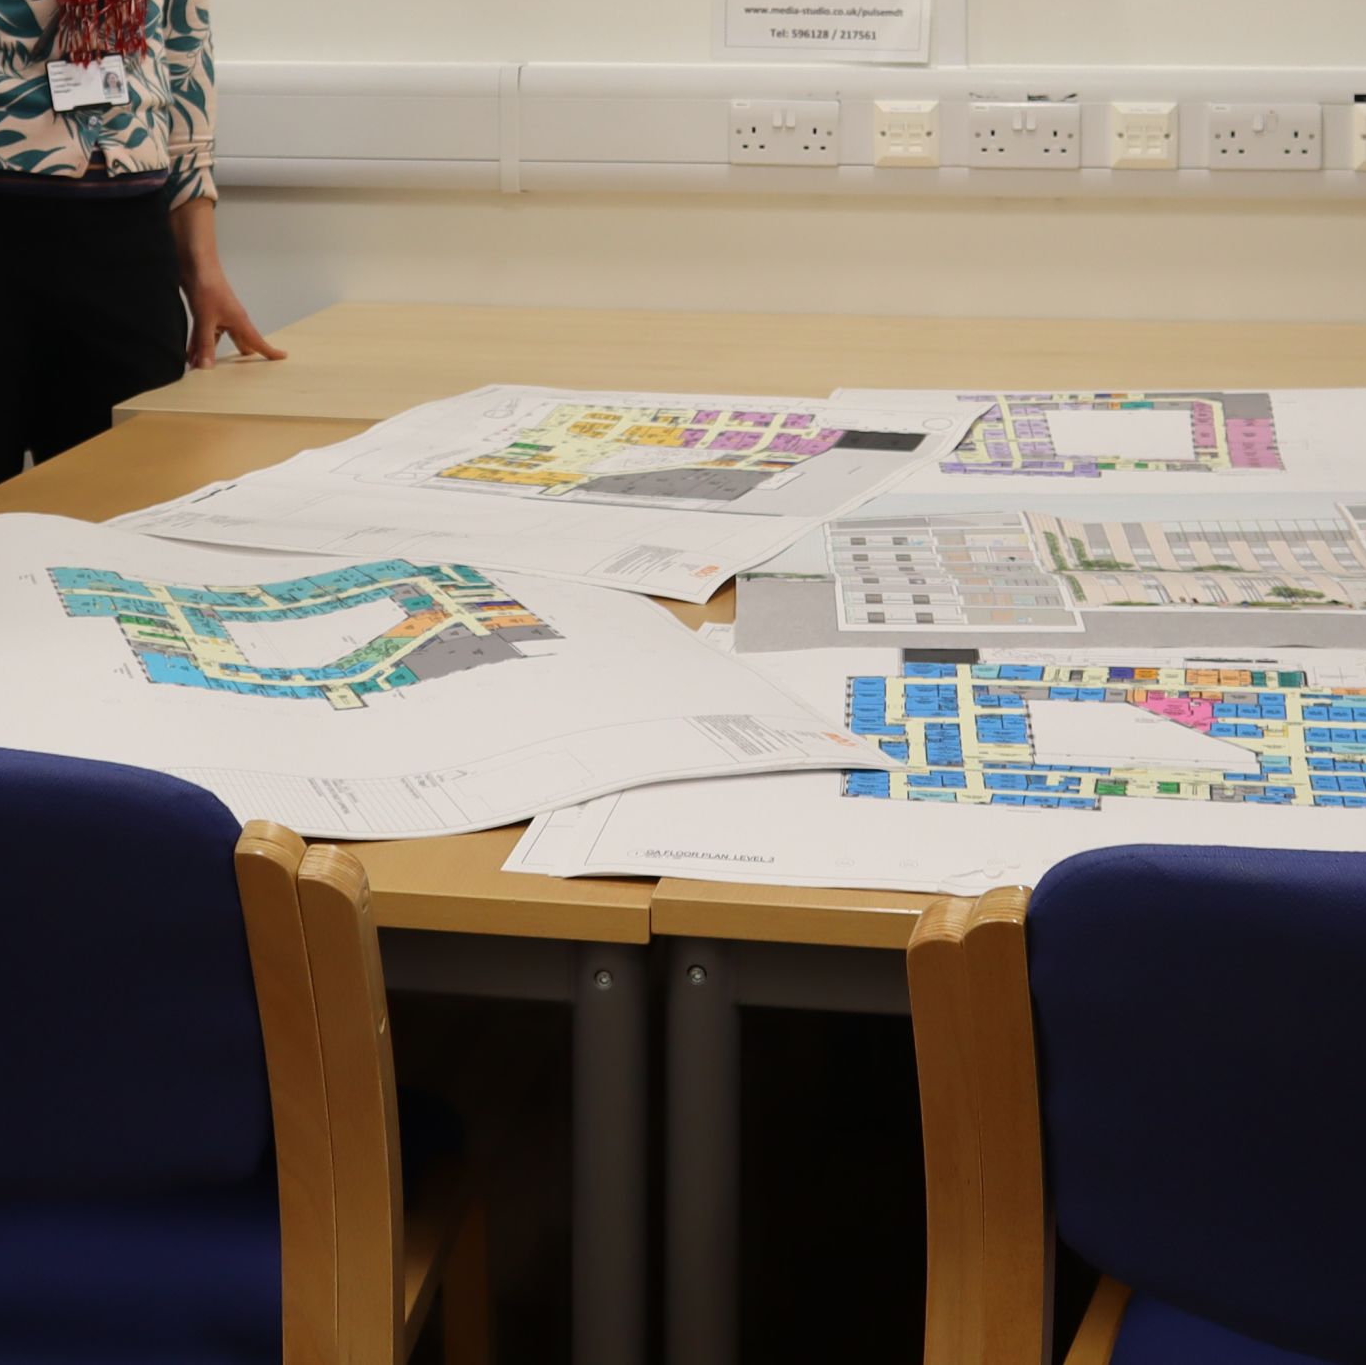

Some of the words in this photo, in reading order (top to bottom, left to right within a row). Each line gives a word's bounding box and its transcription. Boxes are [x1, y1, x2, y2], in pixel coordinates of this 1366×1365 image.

[770, 28, 789, 38] Tel:
[791, 29, 829, 39] 596128
[840, 30, 876, 40] 217561
[662, 849, 700, 859] FLOOR
[733, 854, 765, 862] LEVEL
